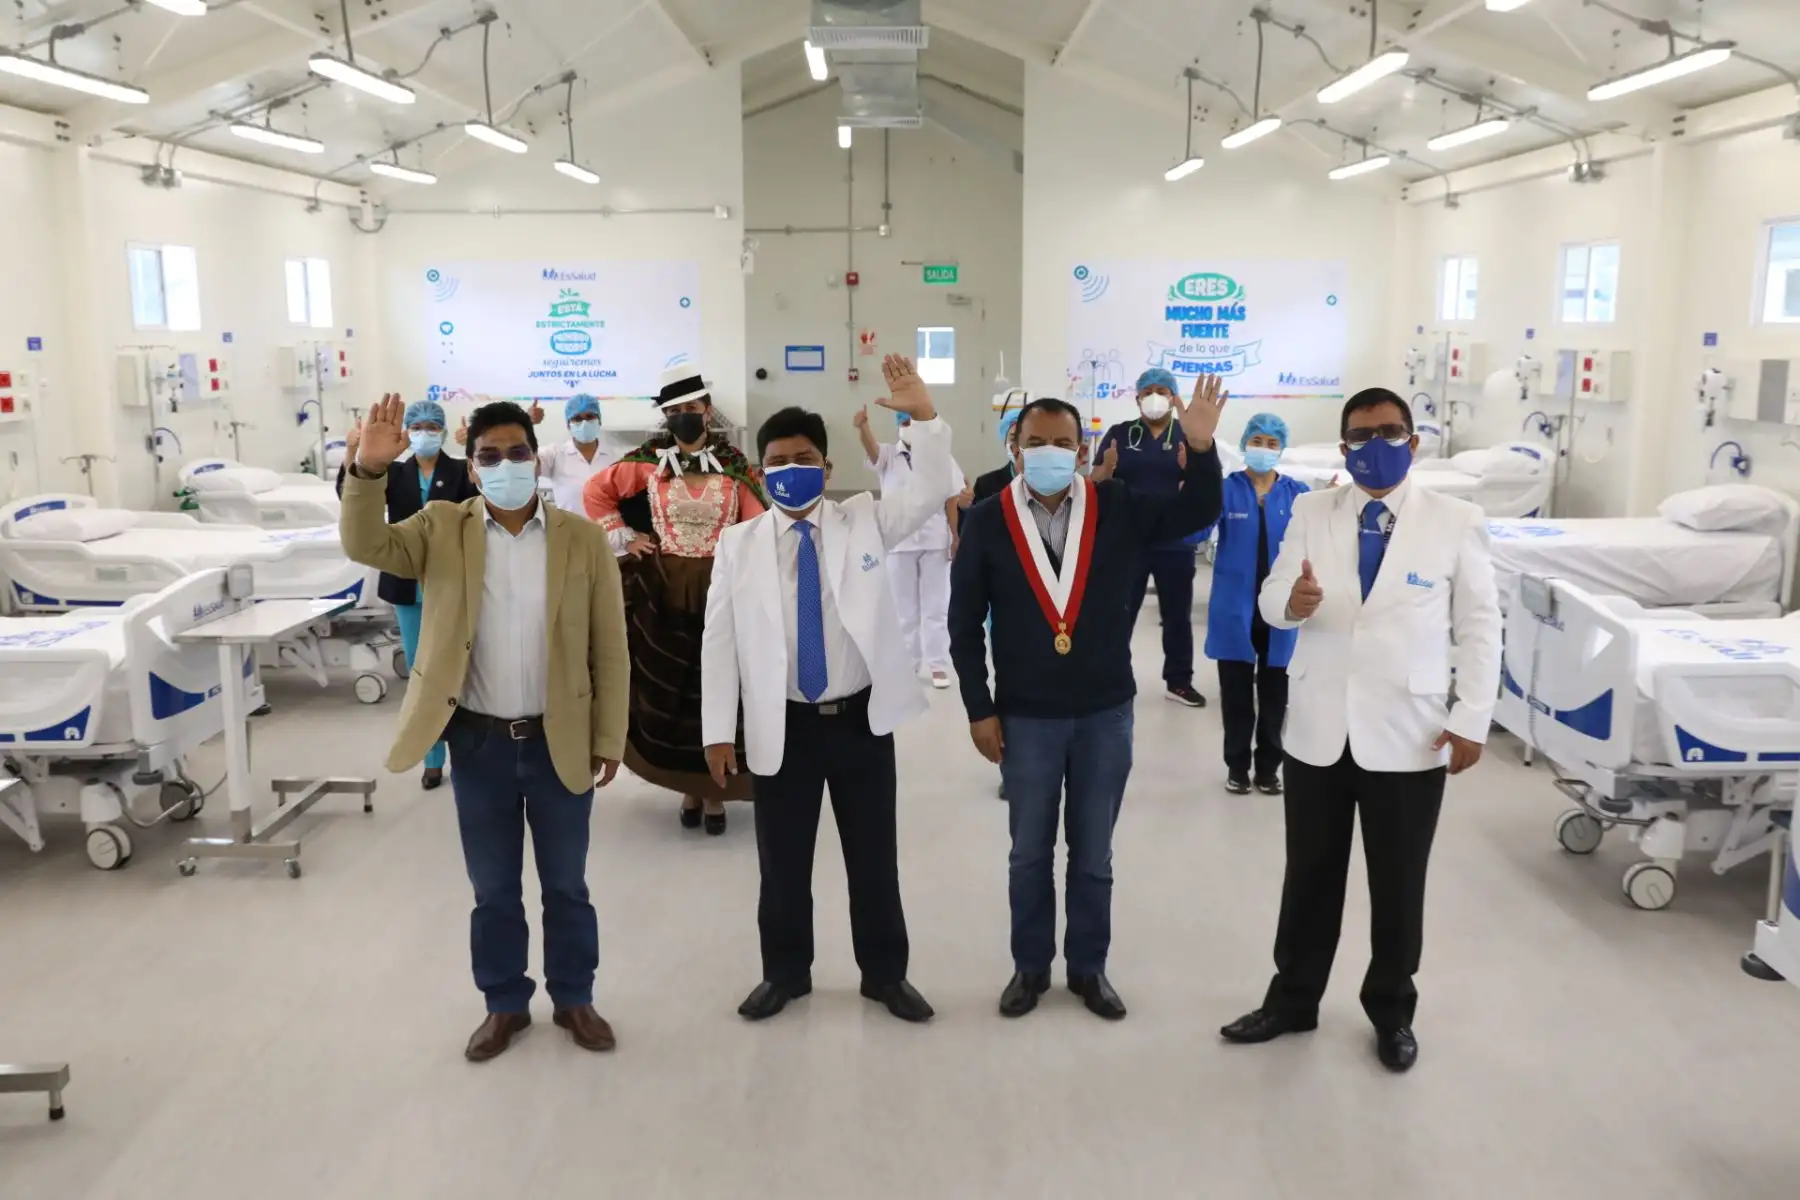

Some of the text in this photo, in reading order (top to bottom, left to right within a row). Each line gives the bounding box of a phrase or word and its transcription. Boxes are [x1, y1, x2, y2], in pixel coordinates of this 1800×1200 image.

[926, 269, 955, 279] SALIDA
[1184, 278, 1229, 297] ERES
[1165, 301, 1246, 321] MUCHO MÁS
[535, 320, 605, 329] ESTRICTAMENTE
[1181, 323, 1229, 338] FUERTE
[1179, 343, 1231, 356] de lo que
[1171, 360, 1234, 374] PIENSAS
[528, 370, 617, 378] JUNTOS EN LA LUCHA
[1299, 376, 1340, 386] EsSalud
